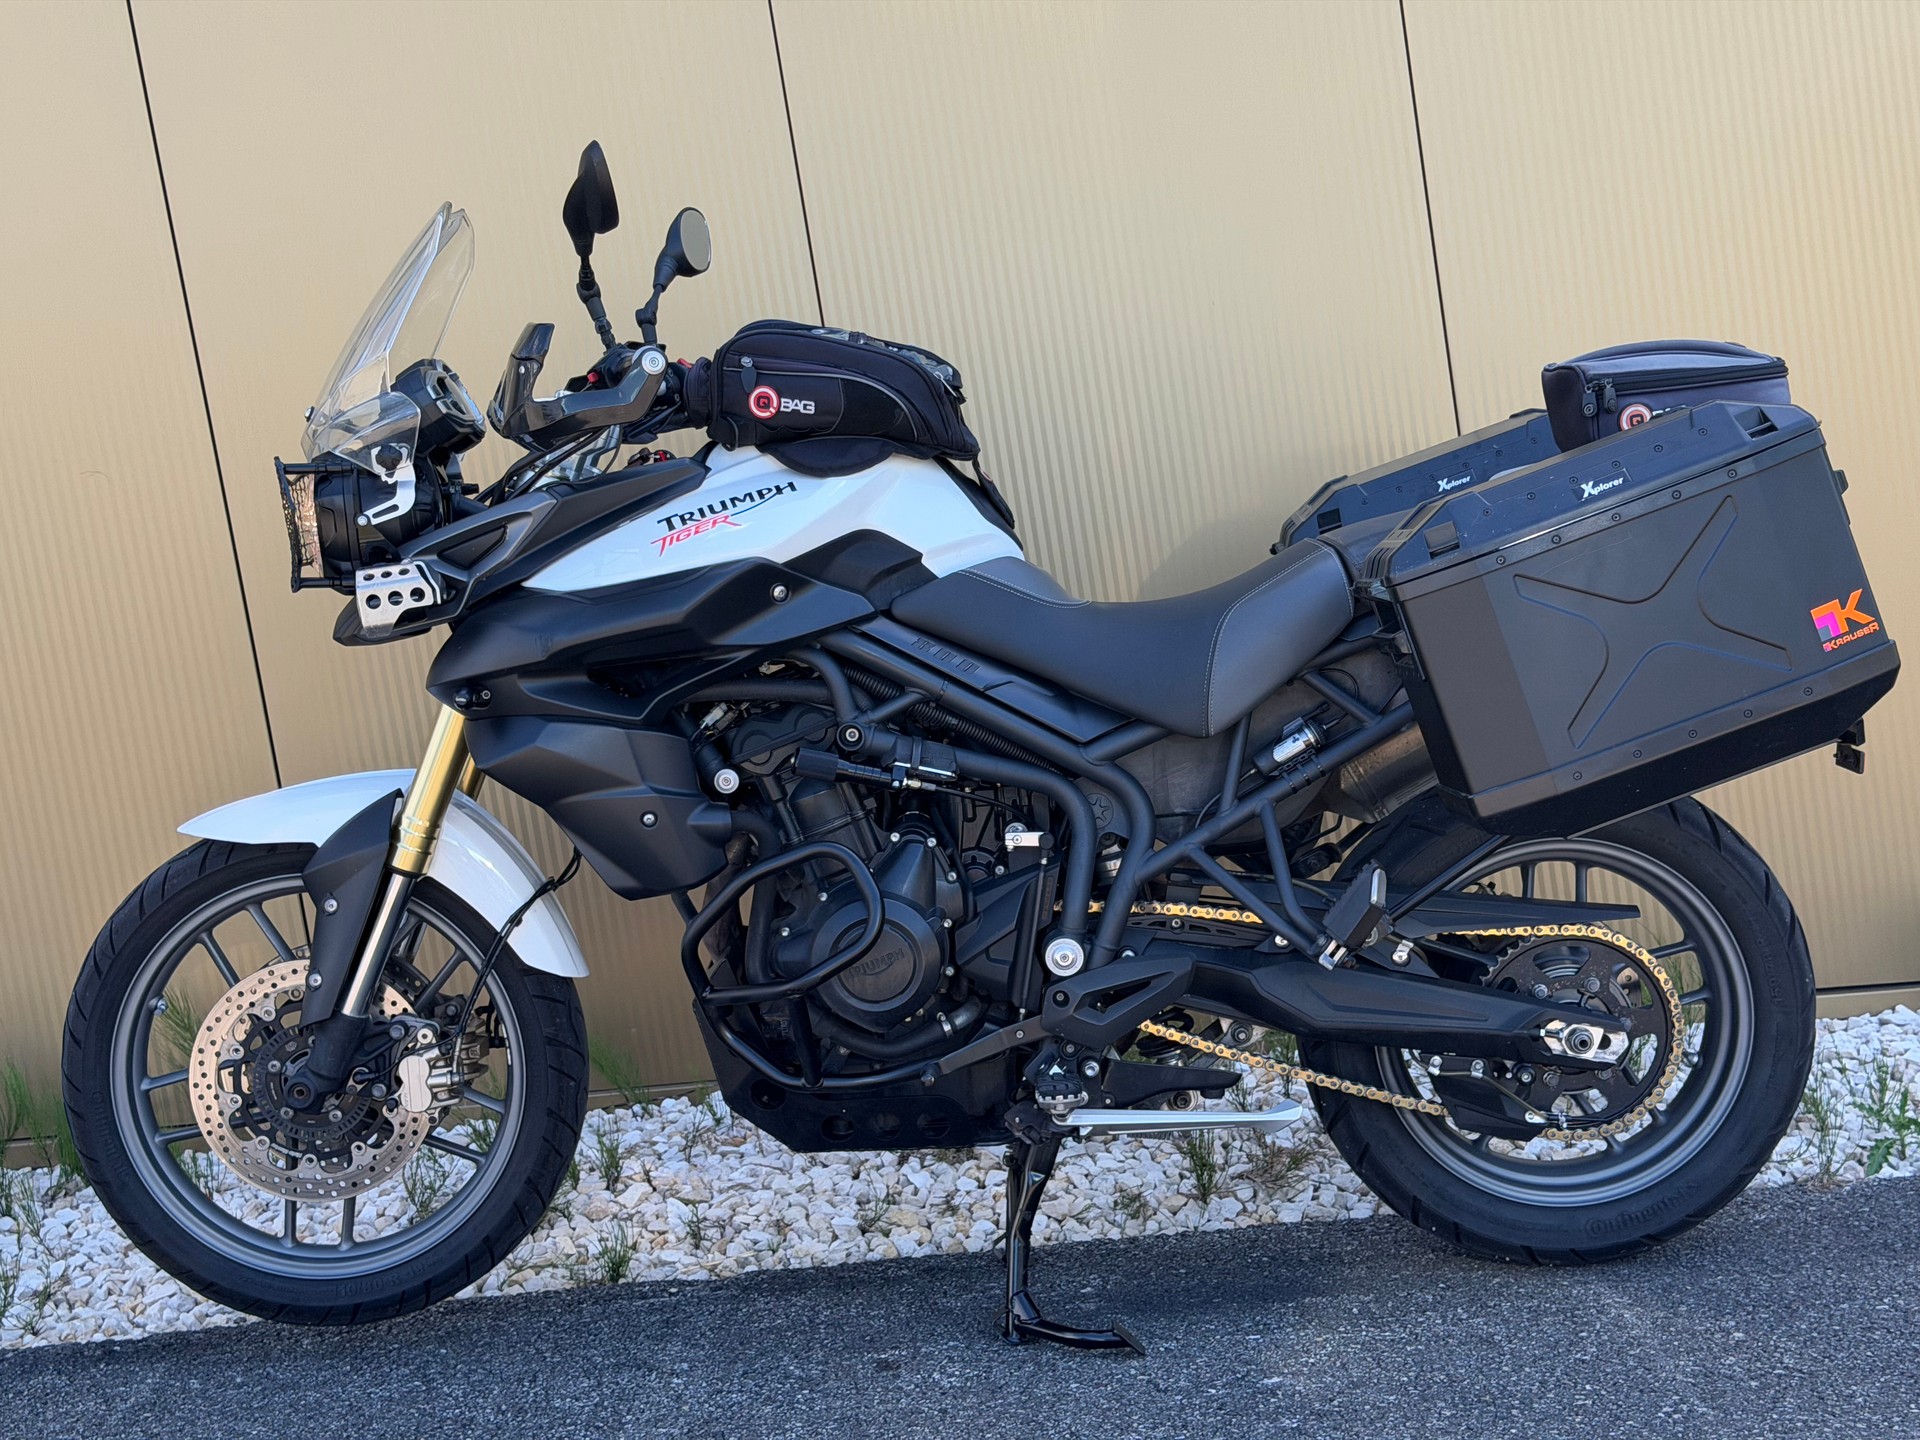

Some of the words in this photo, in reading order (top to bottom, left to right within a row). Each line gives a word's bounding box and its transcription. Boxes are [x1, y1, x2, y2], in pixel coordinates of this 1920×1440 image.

[780, 398, 815, 415] BAG
[1437, 474, 1471, 492] Xplorer
[1580, 477, 1624, 499] Xplorer
[657, 481, 798, 532] TRIUMPH
[651, 513, 742, 557] TIGER
[1823, 621, 1880, 653] KRAUSER
